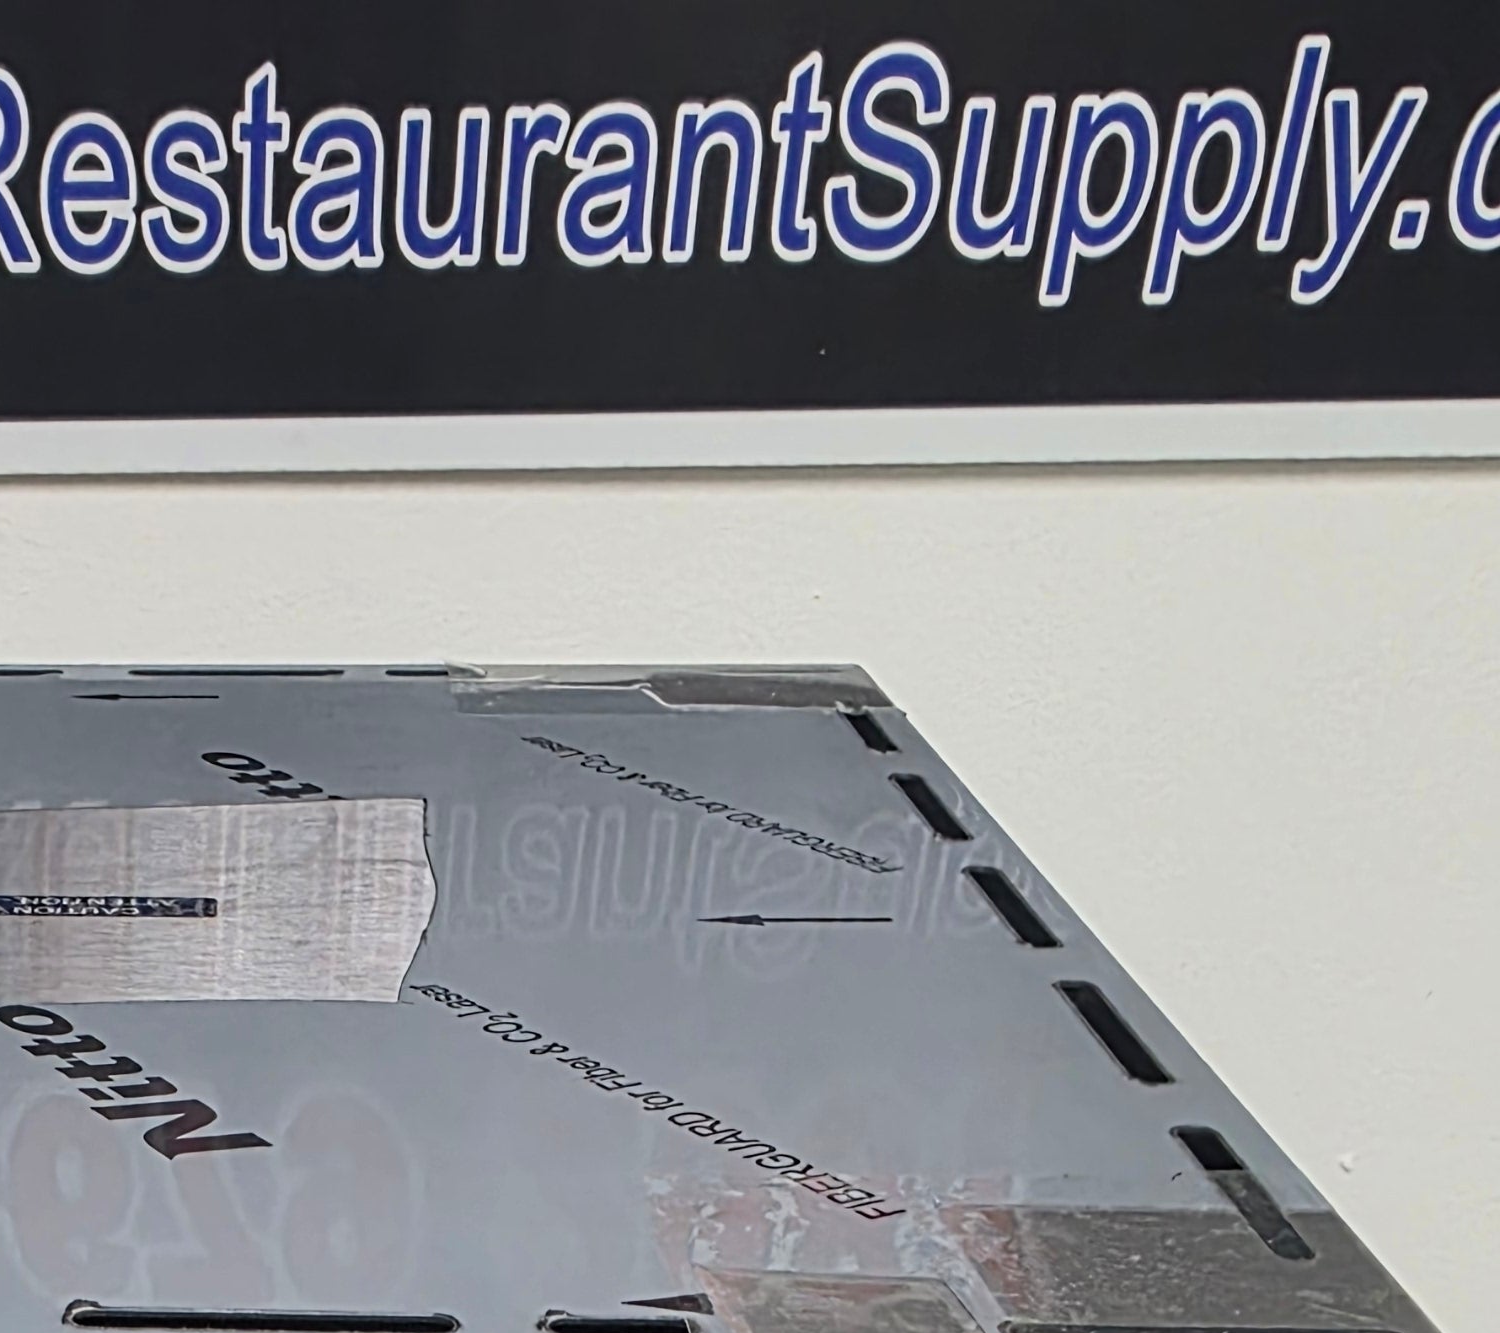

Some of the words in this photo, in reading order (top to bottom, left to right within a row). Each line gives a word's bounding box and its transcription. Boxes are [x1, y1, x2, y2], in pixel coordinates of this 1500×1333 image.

[201, 752, 348, 800] tto
[409, 983, 493, 1019] Laser
[530, 1043, 569, 1059] &
[559, 1055, 640, 1092] Fiber
[630, 1082, 684, 1114] for
[670, 1111, 905, 1221] FIBERGUARD
